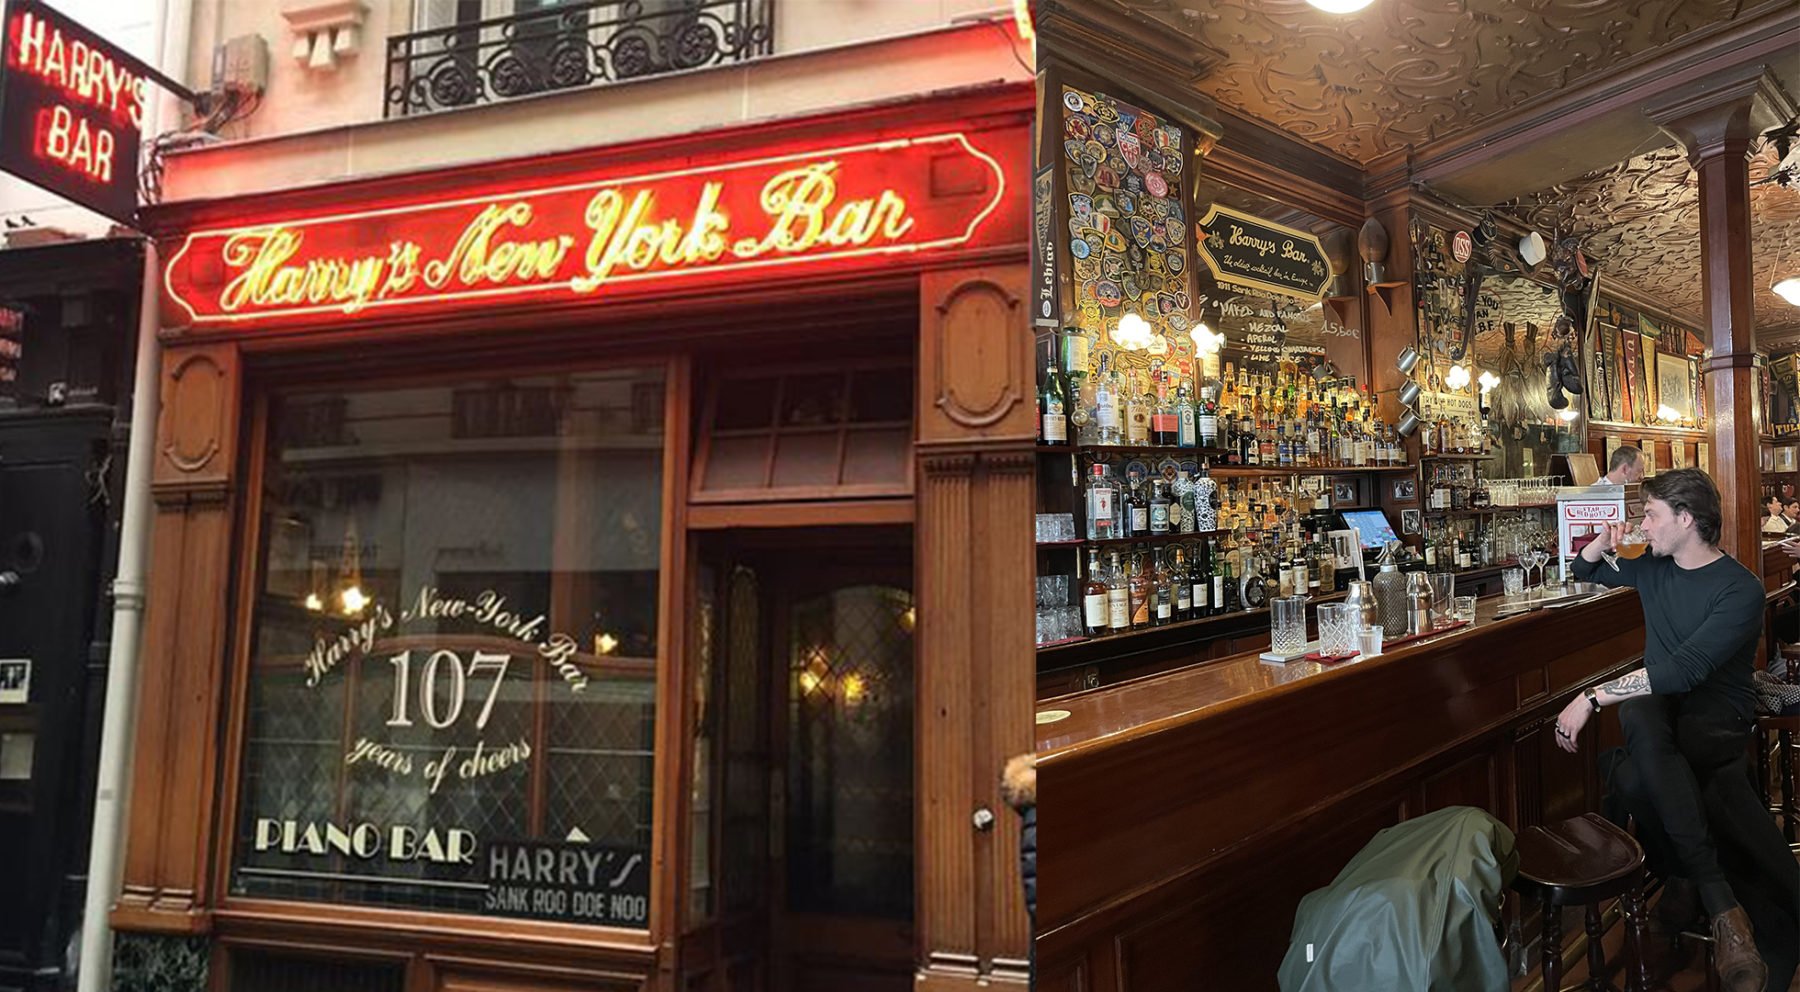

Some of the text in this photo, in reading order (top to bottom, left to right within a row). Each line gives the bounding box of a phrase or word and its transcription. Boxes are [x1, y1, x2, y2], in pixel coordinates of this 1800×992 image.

[19, 12, 149, 130] HARRY'S
[46, 105, 115, 183] BAR
[220, 161, 914, 314] Harry's New York Bar
[1229, 224, 1276, 257] Harry's
[1220, 302, 1254, 318] NAKED
[1480, 295, 1499, 311] YOU
[1246, 333, 1278, 344] APEROL
[1626, 338, 1636, 398] UTAH
[1458, 399, 1473, 409] DOGS
[304, 585, 591, 695] Harry's New-York Bar
[386, 649, 512, 730] 107
[346, 736, 532, 794] years of cheers
[254, 818, 477, 865] PIANO BAR
[489, 846, 643, 888] HARRY'S
[485, 885, 647, 921] SANK ROO DOE NOO
